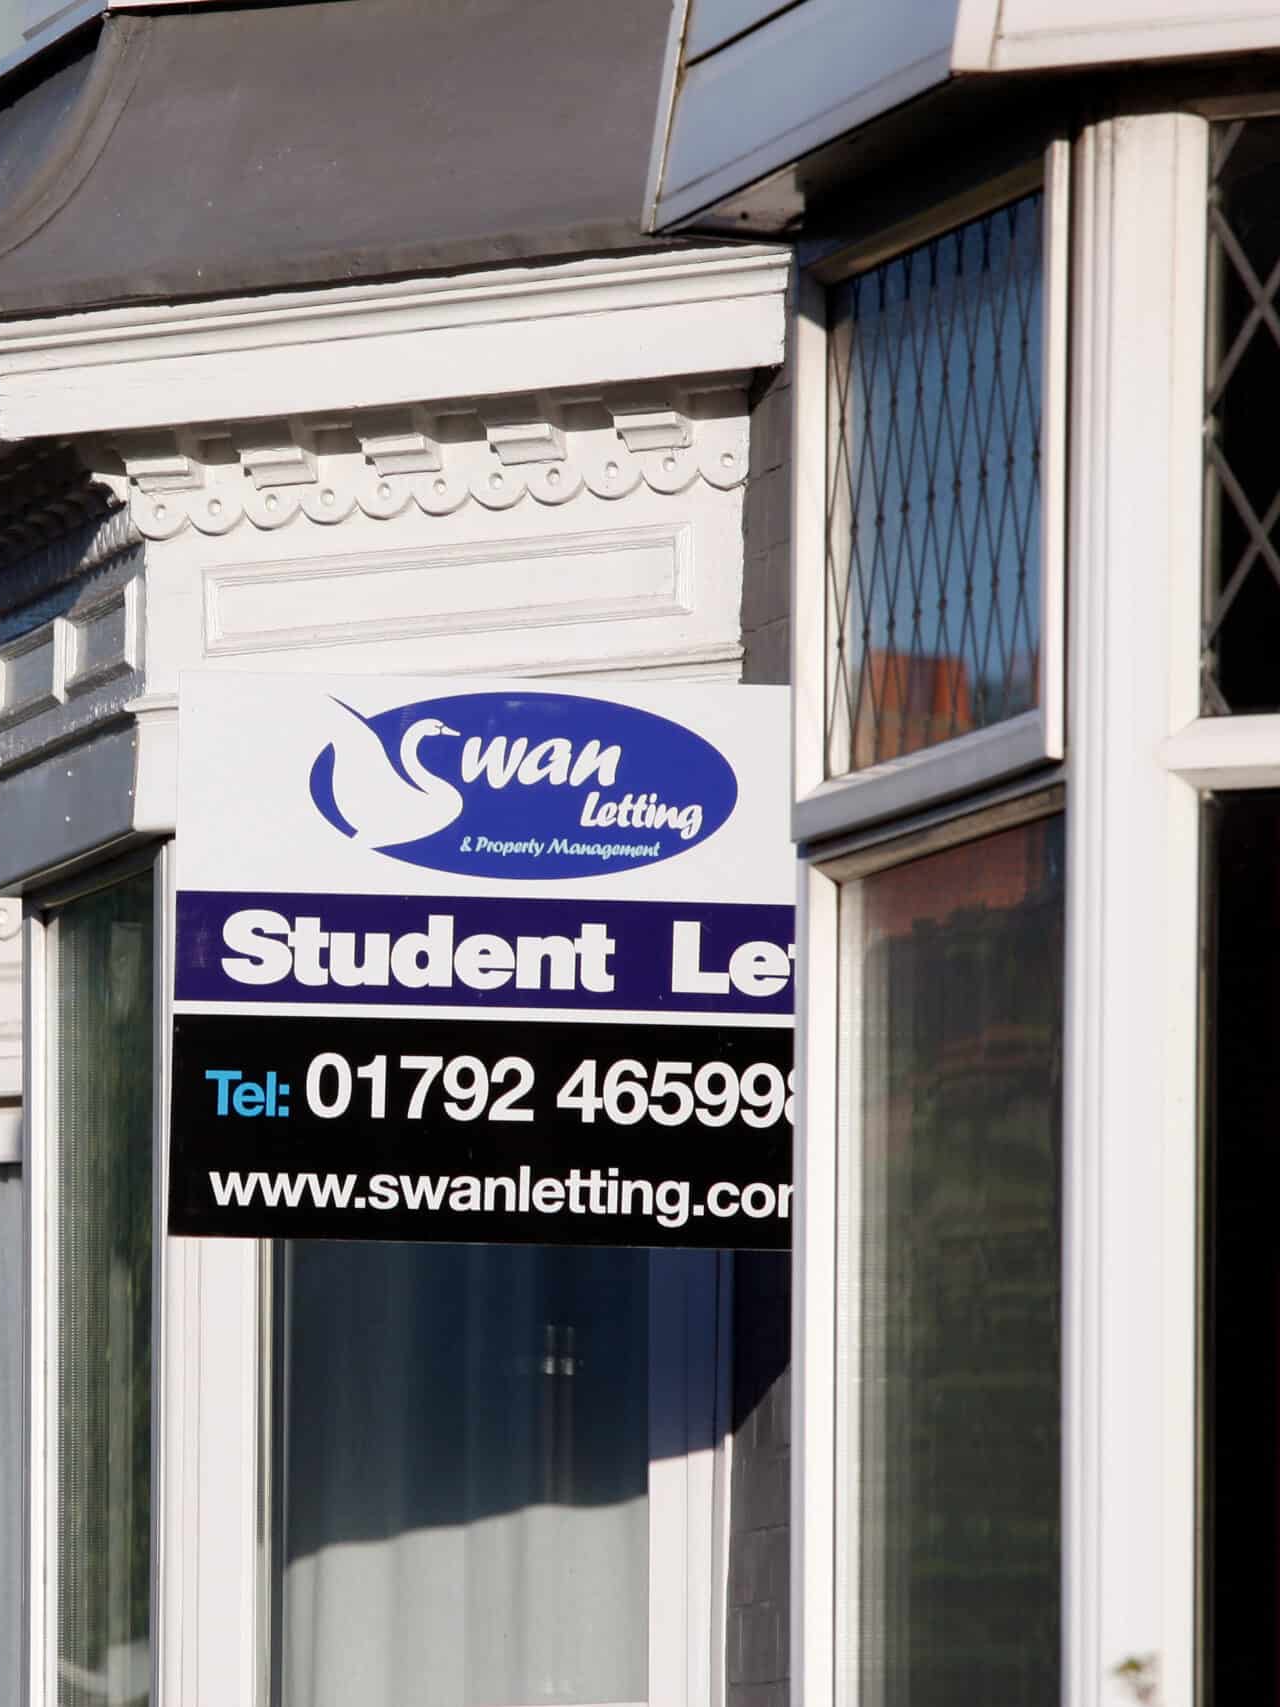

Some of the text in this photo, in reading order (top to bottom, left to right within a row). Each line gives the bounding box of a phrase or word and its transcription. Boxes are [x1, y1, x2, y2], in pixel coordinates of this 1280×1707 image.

[580, 791, 703, 840] Letting
[459, 835, 661, 860] & Property Management
[221, 909, 796, 997] Student Le
[205, 1052, 794, 1129] Tel: 01792 46599
